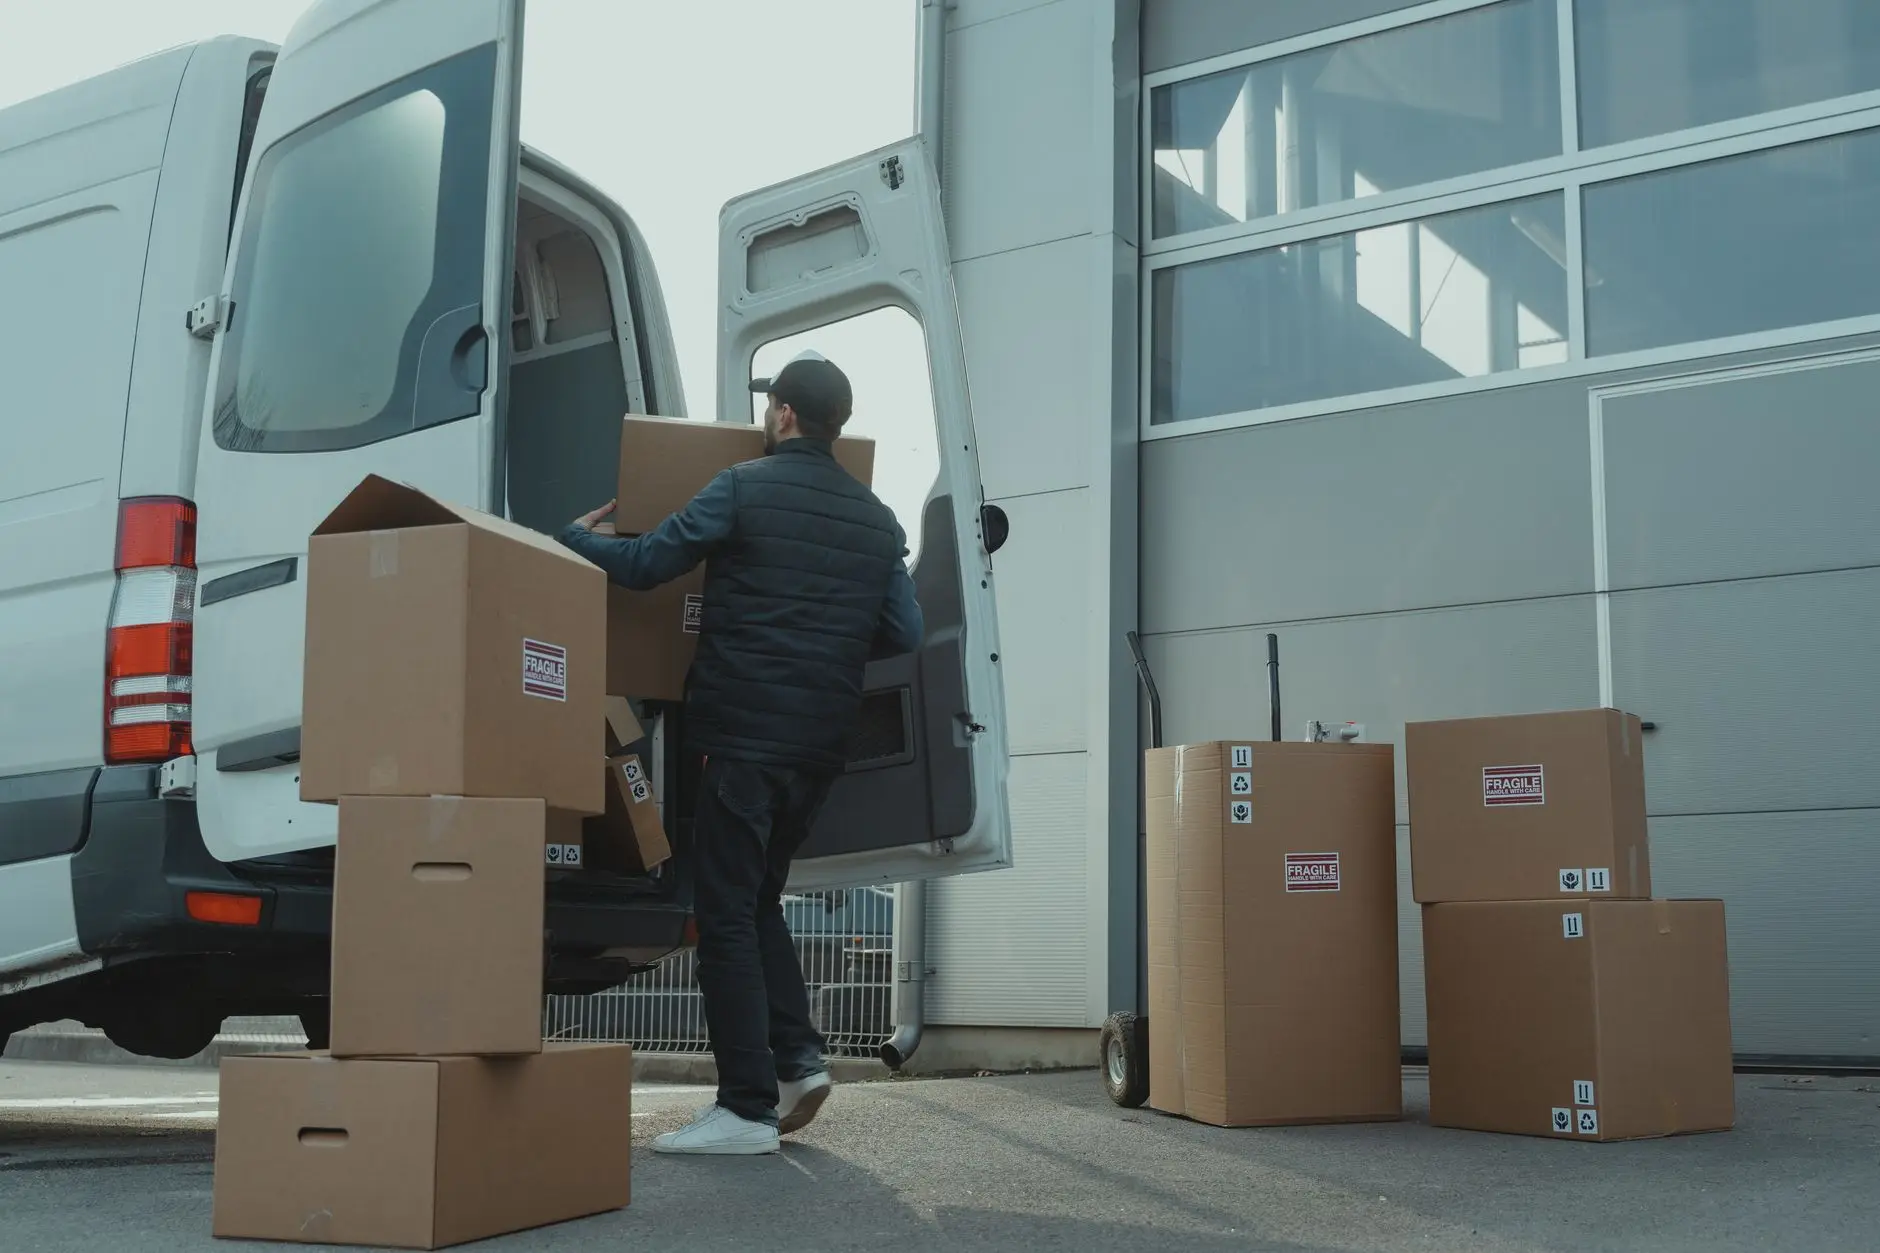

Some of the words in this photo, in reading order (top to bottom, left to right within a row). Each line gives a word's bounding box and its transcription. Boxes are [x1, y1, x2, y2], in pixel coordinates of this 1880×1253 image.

[525, 656, 564, 678] FRAGILE
[1486, 777, 1540, 790] FRAGILE
[1288, 864, 1337, 876] FRAGILE
